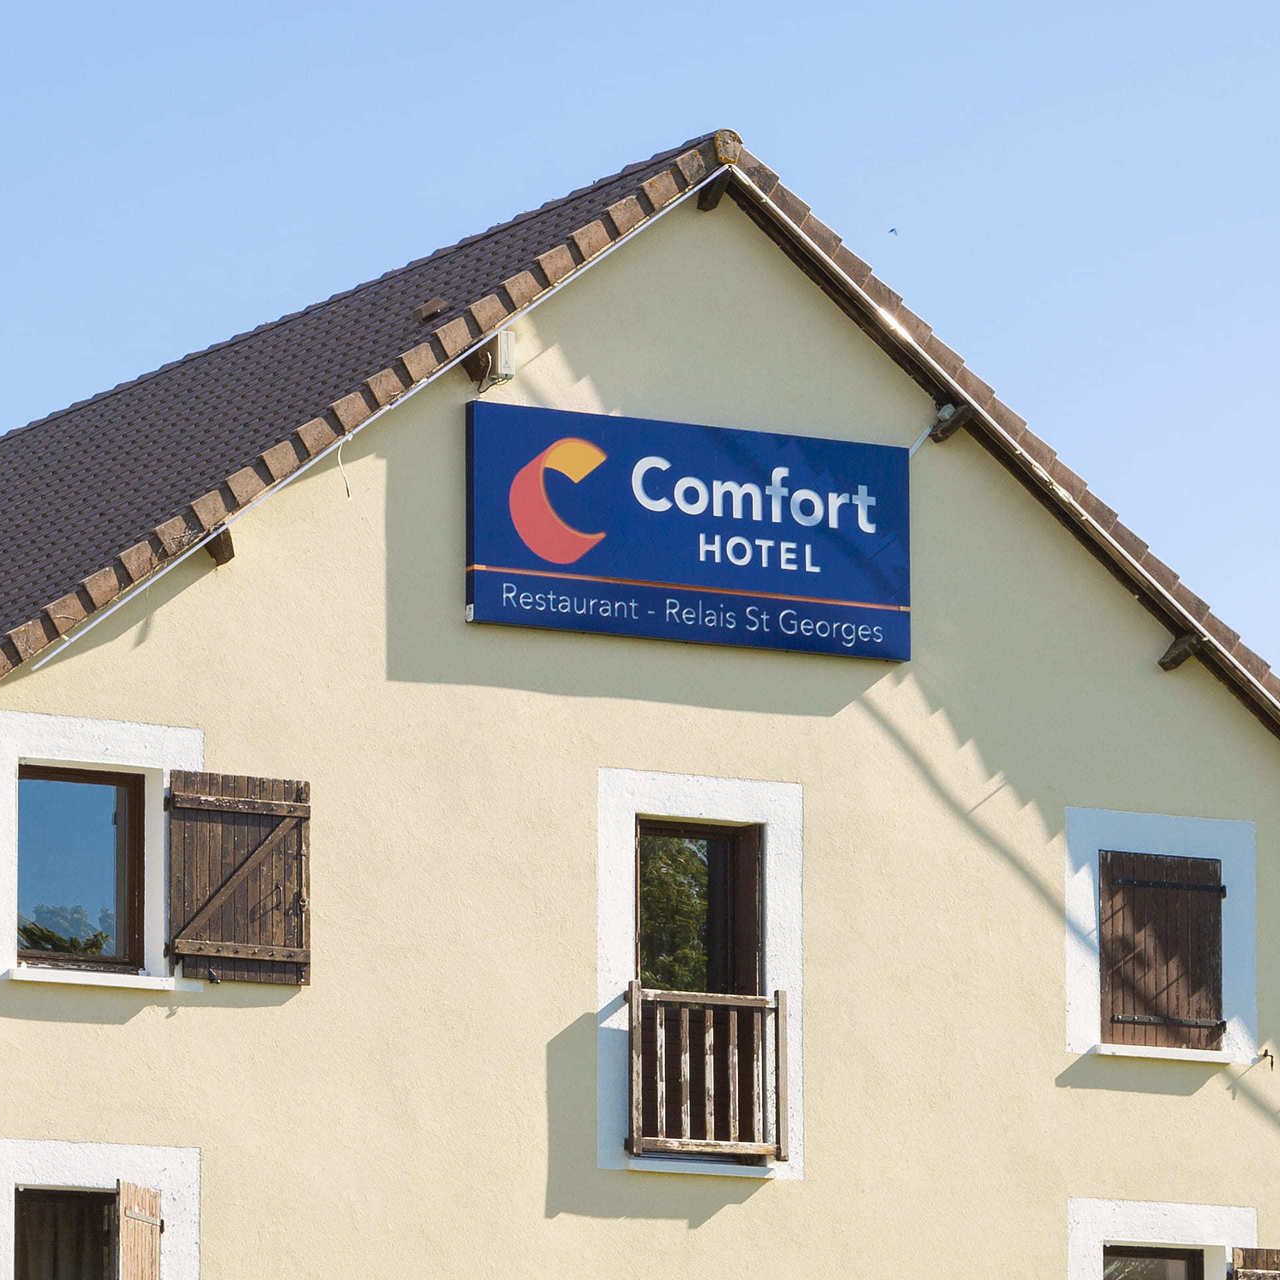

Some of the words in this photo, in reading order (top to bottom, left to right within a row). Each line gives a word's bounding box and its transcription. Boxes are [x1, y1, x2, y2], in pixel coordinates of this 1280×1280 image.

[632, 456, 876, 533] Comfort
[700, 533, 820, 573] HOTEL
[503, 583, 638, 619] Restaurant
[666, 599, 736, 629] Relais
[746, 607, 770, 632] St
[779, 610, 883, 648] Georges
